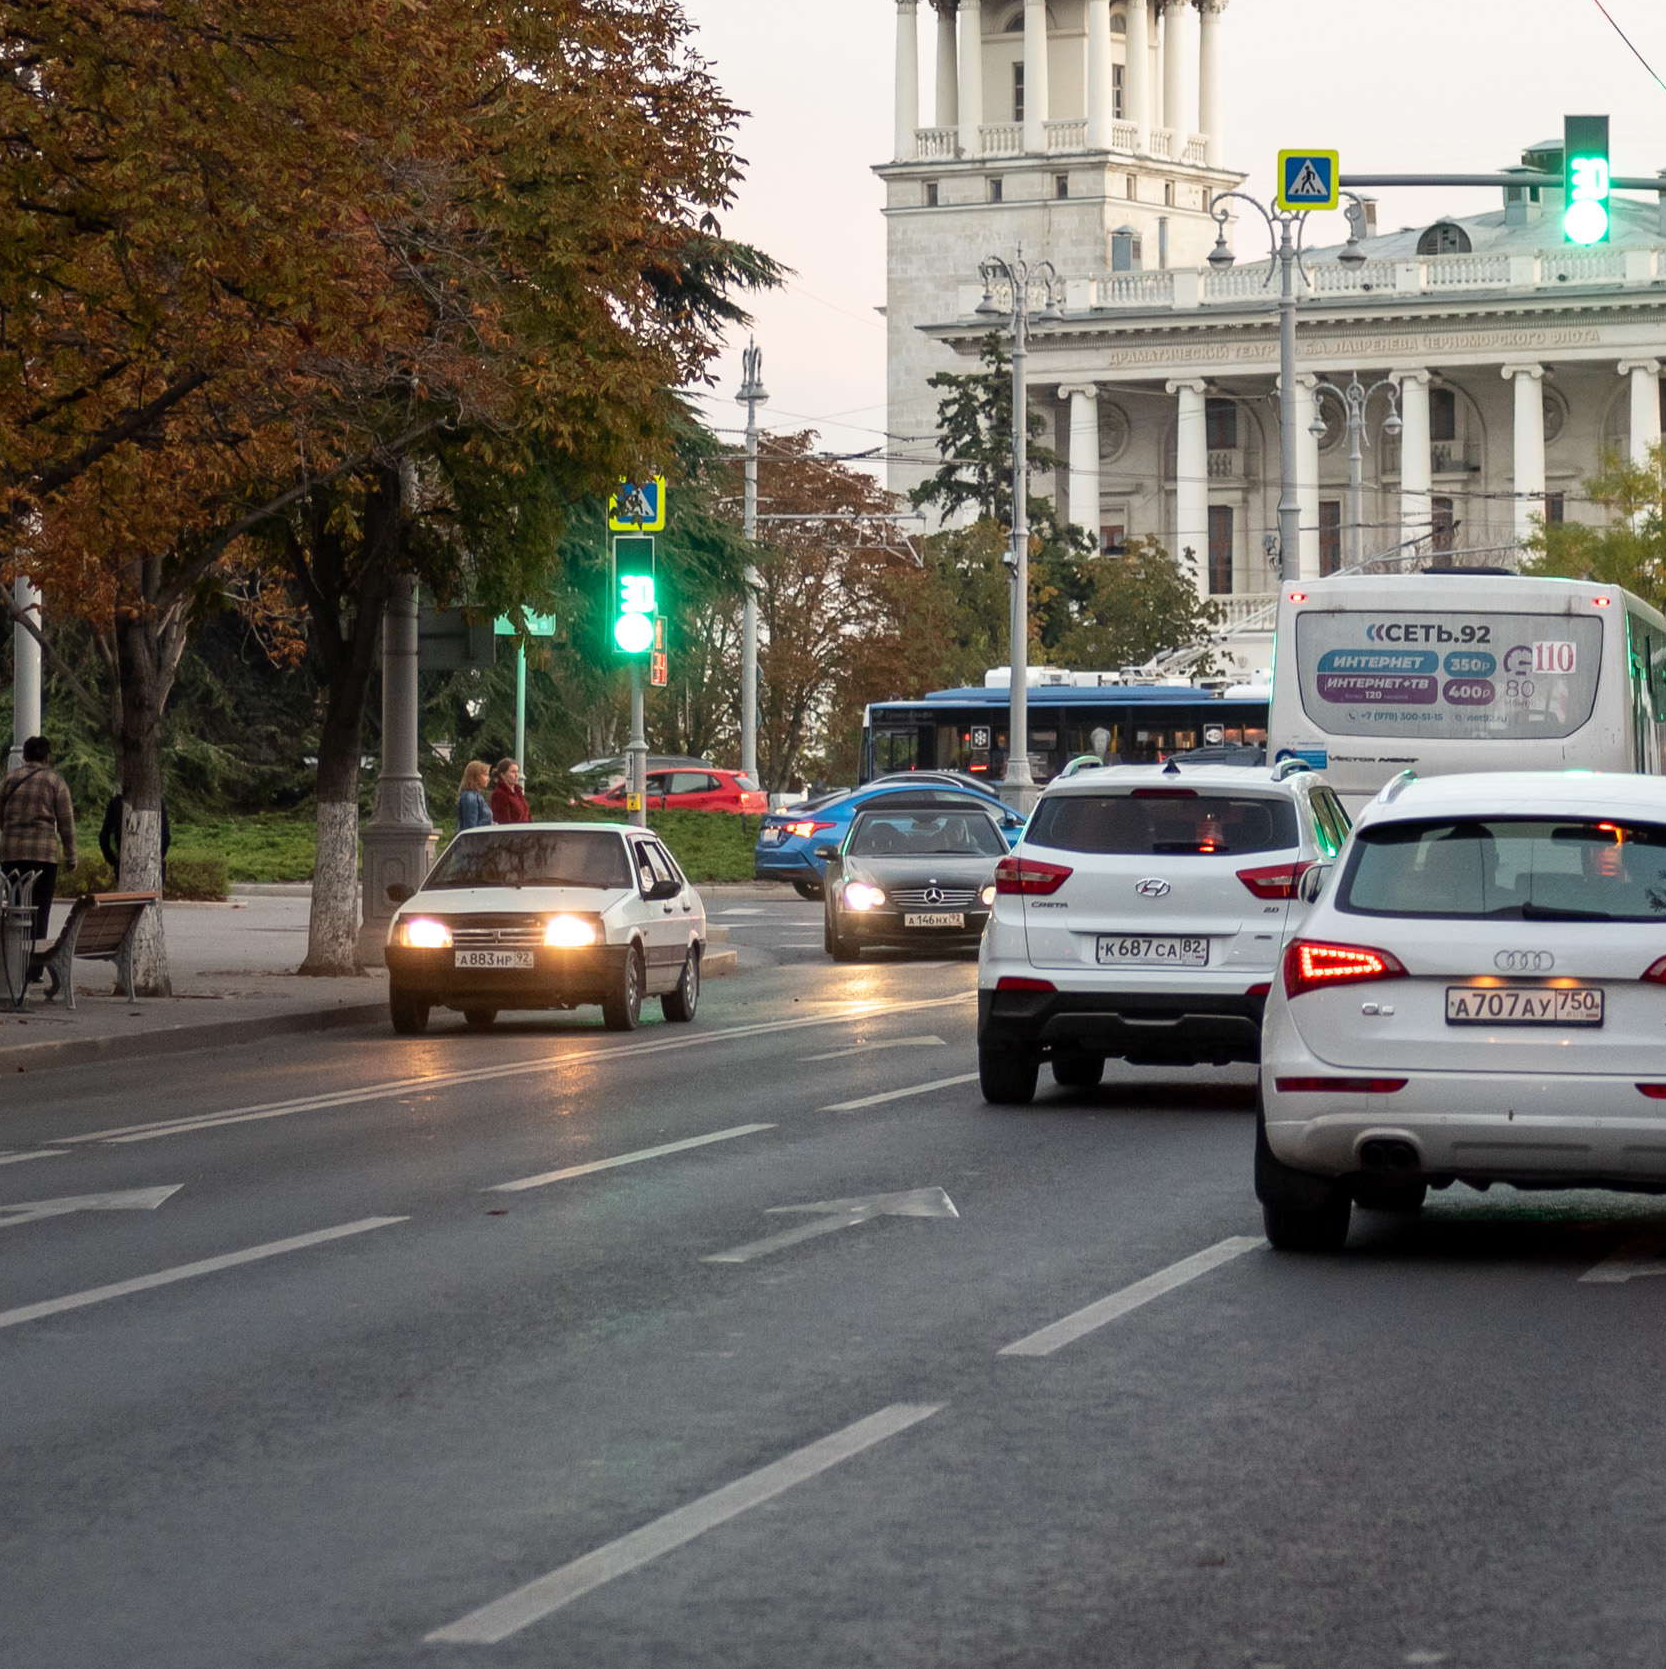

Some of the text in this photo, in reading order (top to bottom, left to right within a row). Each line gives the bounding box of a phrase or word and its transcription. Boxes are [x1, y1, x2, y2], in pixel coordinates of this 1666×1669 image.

[1108, 346, 1228, 366] ДРАМАТИЧЕСКИЙ
[1233, 343, 1275, 360] ТЕАТР
[1334, 337, 1418, 354] ЛАВРЕНЕВА
[1422, 331, 1545, 349] ЧЕРНОМОРСКОГО
[1549, 329, 1600, 343] ФЛОТА
[1385, 623, 1491, 644] СЕТЬ.92
[1333, 656, 1424, 669] ИНТЕРНЕТ
[1535, 642, 1574, 672] 110
[1326, 677, 1429, 689] ИНТЕРНЕТ+ТВ
[1505, 679, 1535, 698] 80
[1365, 690, 1382, 699] 120
[1183, 940, 1201, 954] 82
[517, 952, 530, 963] 92
[1558, 992, 1596, 1011] 750
